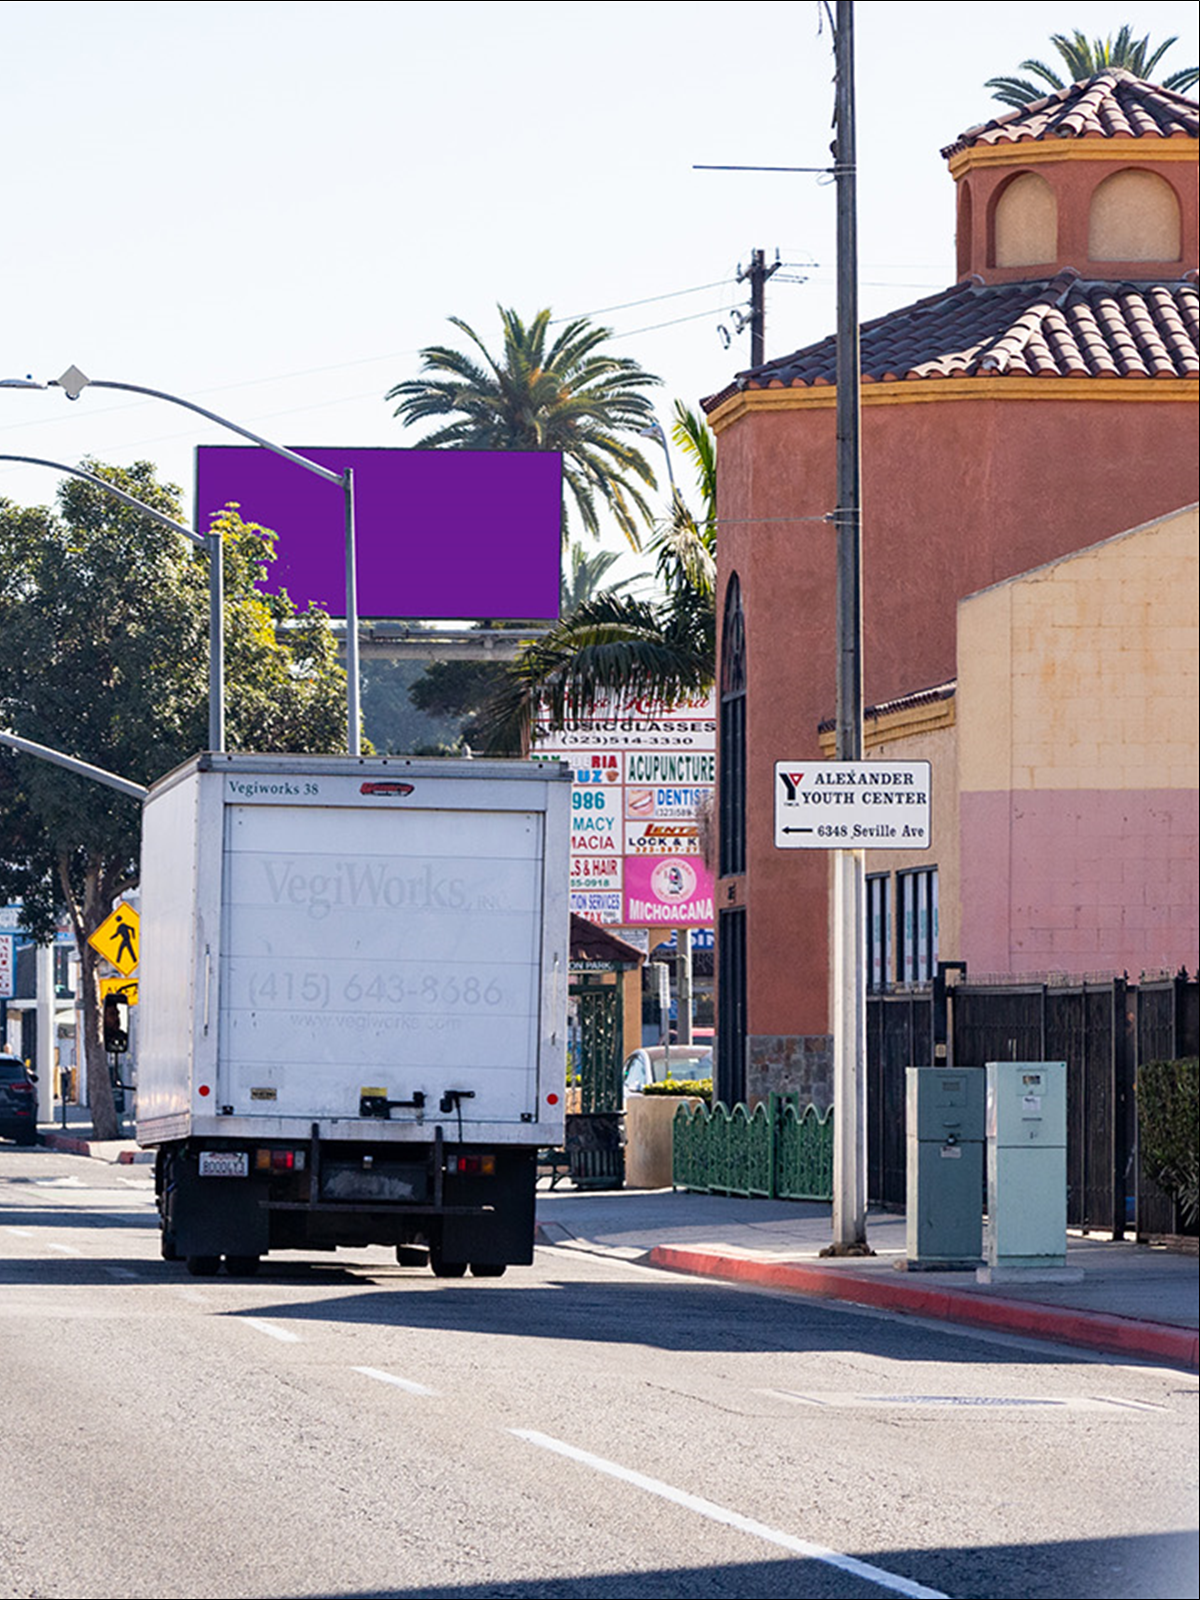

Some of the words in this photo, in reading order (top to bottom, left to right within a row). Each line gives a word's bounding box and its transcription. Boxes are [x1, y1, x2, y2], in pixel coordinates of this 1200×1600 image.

[549, 722, 616, 733] USIC
[620, 722, 716, 733] CLASSES
[561, 737, 693, 745] (323)514-3330
[628, 756, 715, 782] ACUPUNCTURE
[814, 773, 914, 785] ALEXANDER
[229, 781, 300, 796] Vegiworks
[303, 783, 319, 795] 38
[802, 792, 854, 804] YOUTH
[862, 792, 927, 805] CENTER
[817, 825, 848, 837] 6348
[852, 824, 897, 837] Seville
[901, 825, 925, 837] Ave
[628, 838, 667, 846] LOCK
[584, 860, 591, 876] &
[593, 860, 618, 876] HAIR
[629, 898, 714, 920] MICHOACANA
[249, 972, 331, 1008] (415)
[343, 973, 503, 1006] 643-8686
